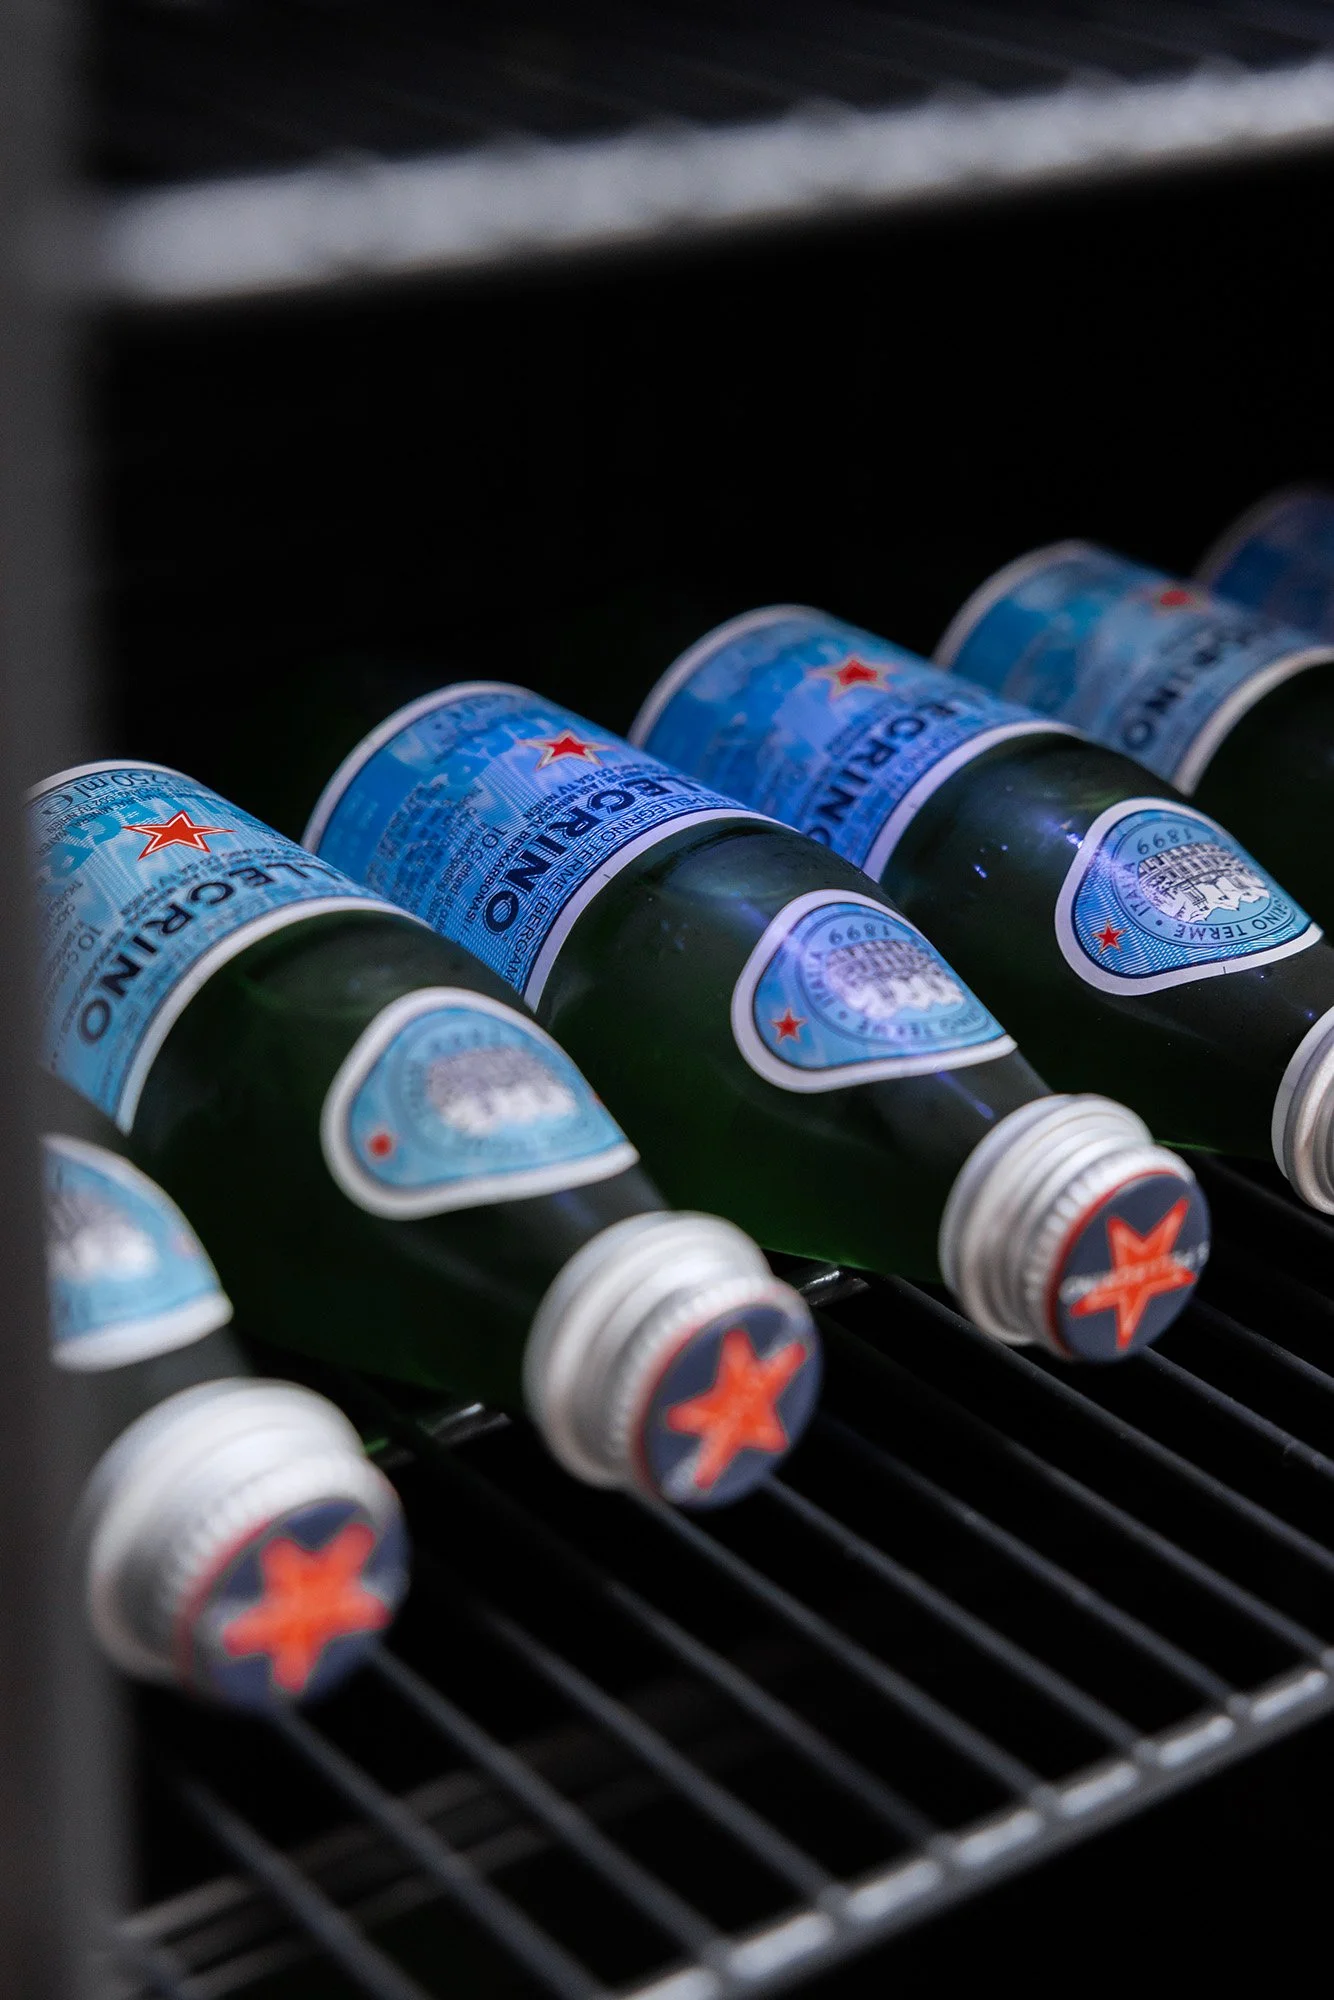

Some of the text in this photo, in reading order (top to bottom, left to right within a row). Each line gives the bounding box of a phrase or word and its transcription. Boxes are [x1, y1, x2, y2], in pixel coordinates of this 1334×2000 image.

[1136, 827, 1194, 856] 1899
[464, 830, 532, 925] BERKARBONASI
[549, 843, 604, 895] TERME
[1119, 861, 1152, 918] ITALIA
[828, 921, 891, 946] 1899
[1172, 923, 1248, 942] TERME
